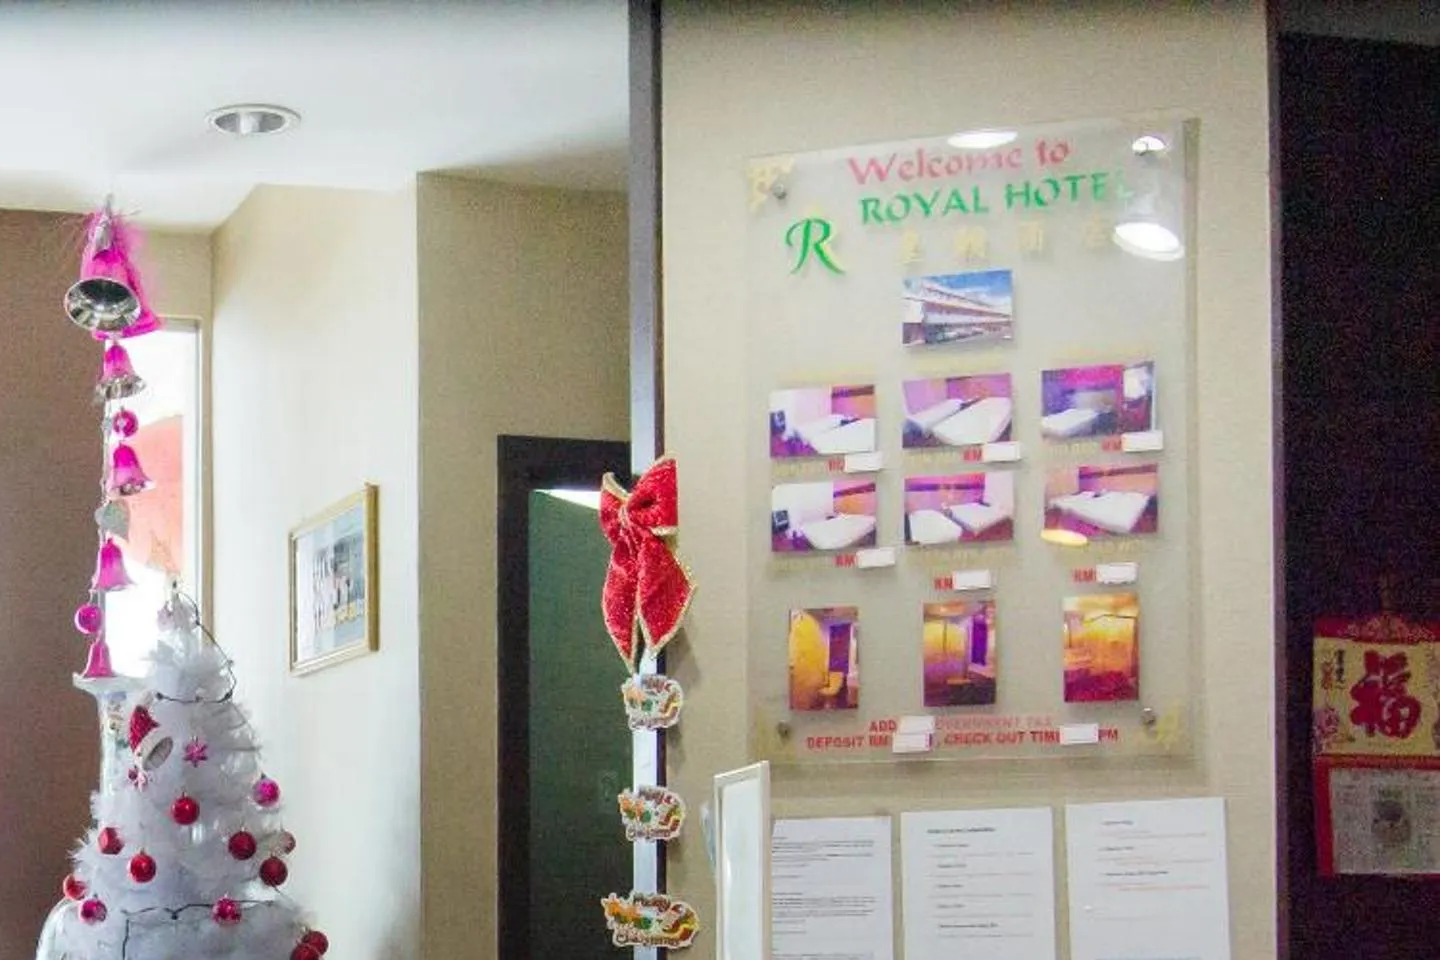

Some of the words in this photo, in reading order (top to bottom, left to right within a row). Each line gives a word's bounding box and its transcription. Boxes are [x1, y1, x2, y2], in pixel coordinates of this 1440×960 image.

[848, 147, 1023, 185] Welcome
[1036, 138, 1071, 165] to
[859, 186, 990, 224] ROYAL
[786, 217, 846, 275] R
[806, 736, 864, 748] DEPOSIT
[945, 731, 990, 744] CHECK
[995, 730, 1025, 743] OUT
[869, 719, 897, 733] ADD
